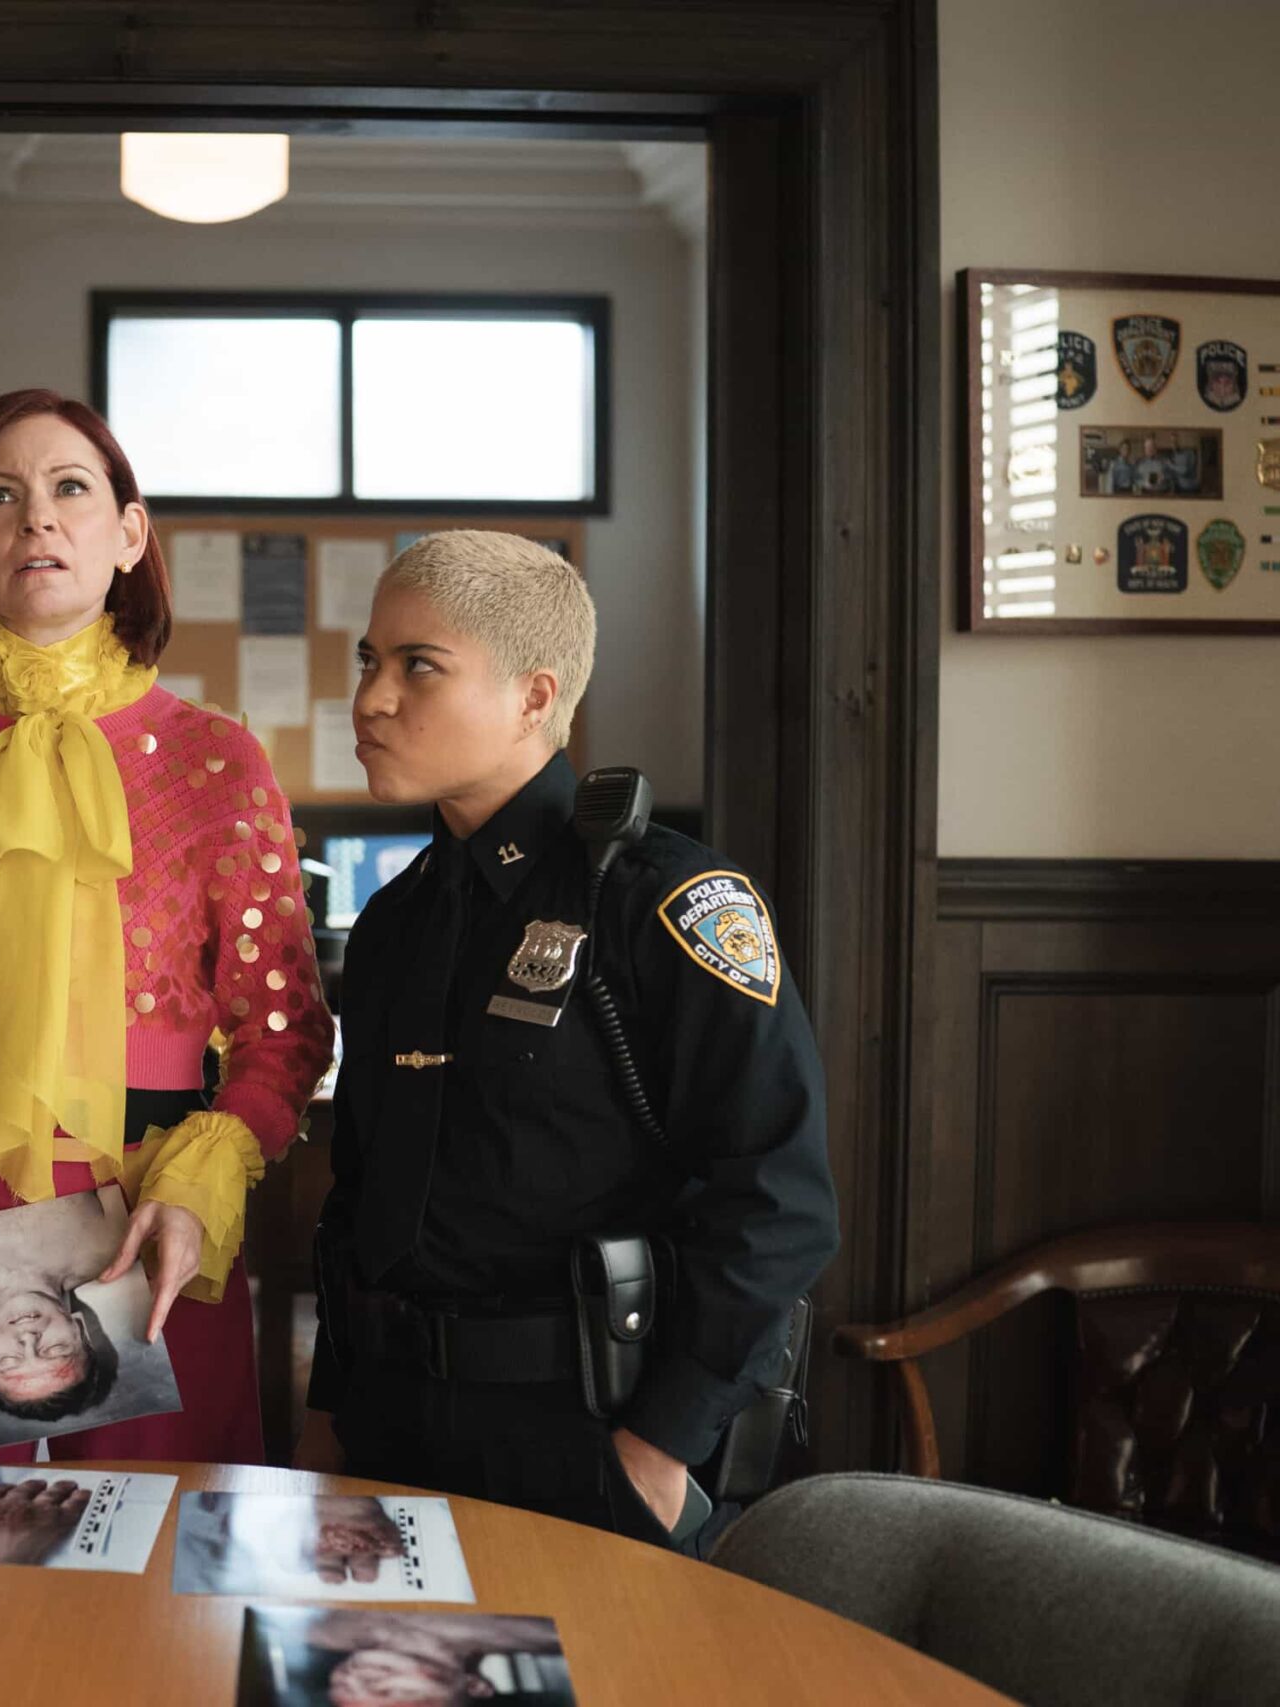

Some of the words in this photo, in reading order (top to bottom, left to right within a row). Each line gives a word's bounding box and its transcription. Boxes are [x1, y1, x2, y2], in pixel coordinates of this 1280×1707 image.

[497, 842, 525, 865] 11
[686, 879, 736, 904] POLICE
[678, 891, 758, 931] DEPARTMENT
[694, 943, 727, 971] CITY
[727, 968, 751, 985] OF
